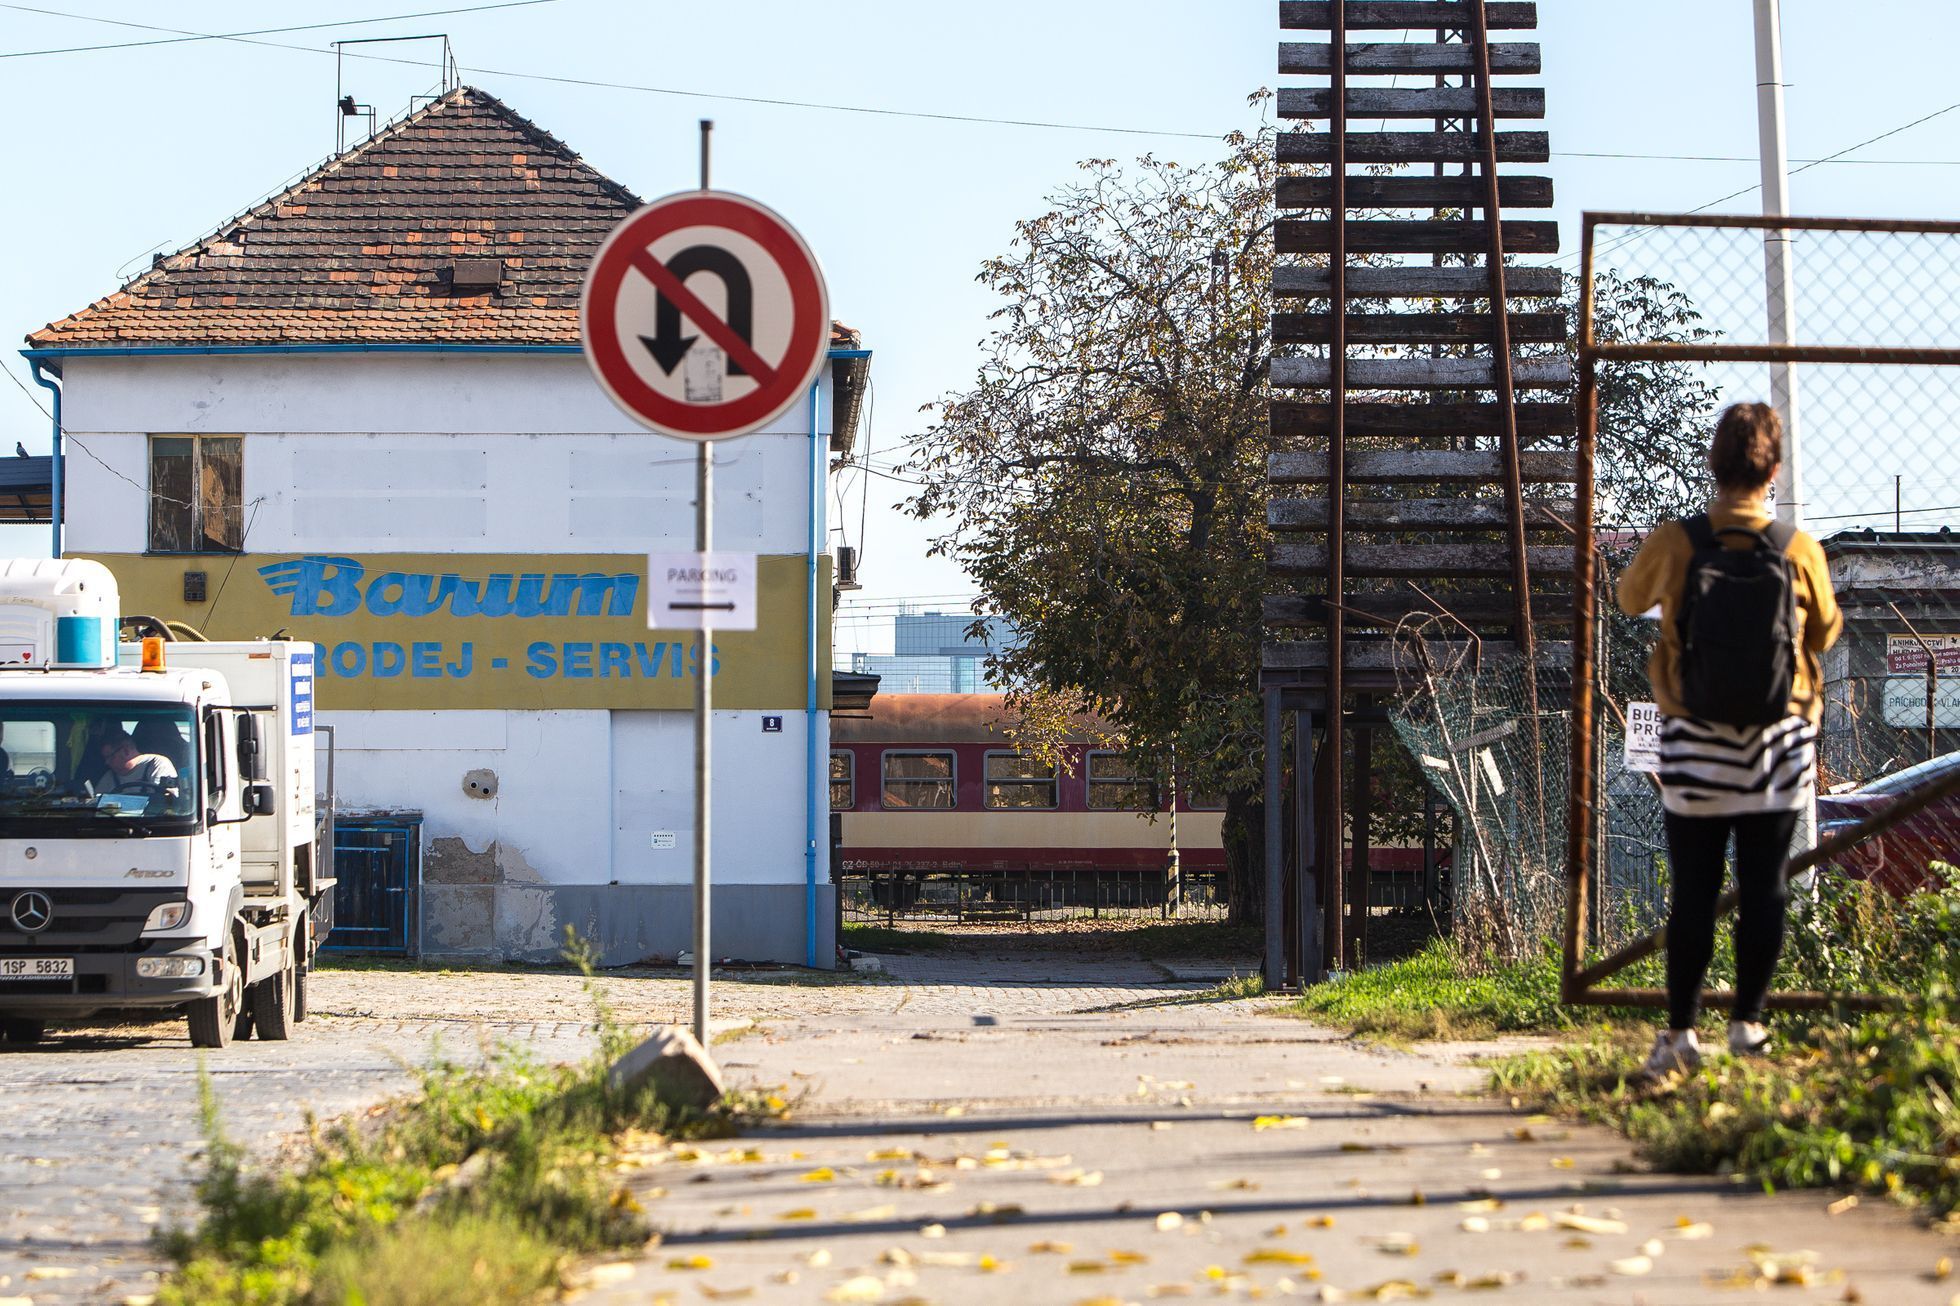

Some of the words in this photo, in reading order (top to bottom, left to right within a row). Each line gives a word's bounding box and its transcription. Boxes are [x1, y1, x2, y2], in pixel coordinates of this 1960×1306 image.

[667, 568, 737, 583] PARKING
[284, 555, 640, 617] Barum
[526, 641, 720, 679] SERVIS
[769, 718, 775, 727] 8
[3, 960, 27, 974] 1SP
[36, 960, 68, 974] 5832
